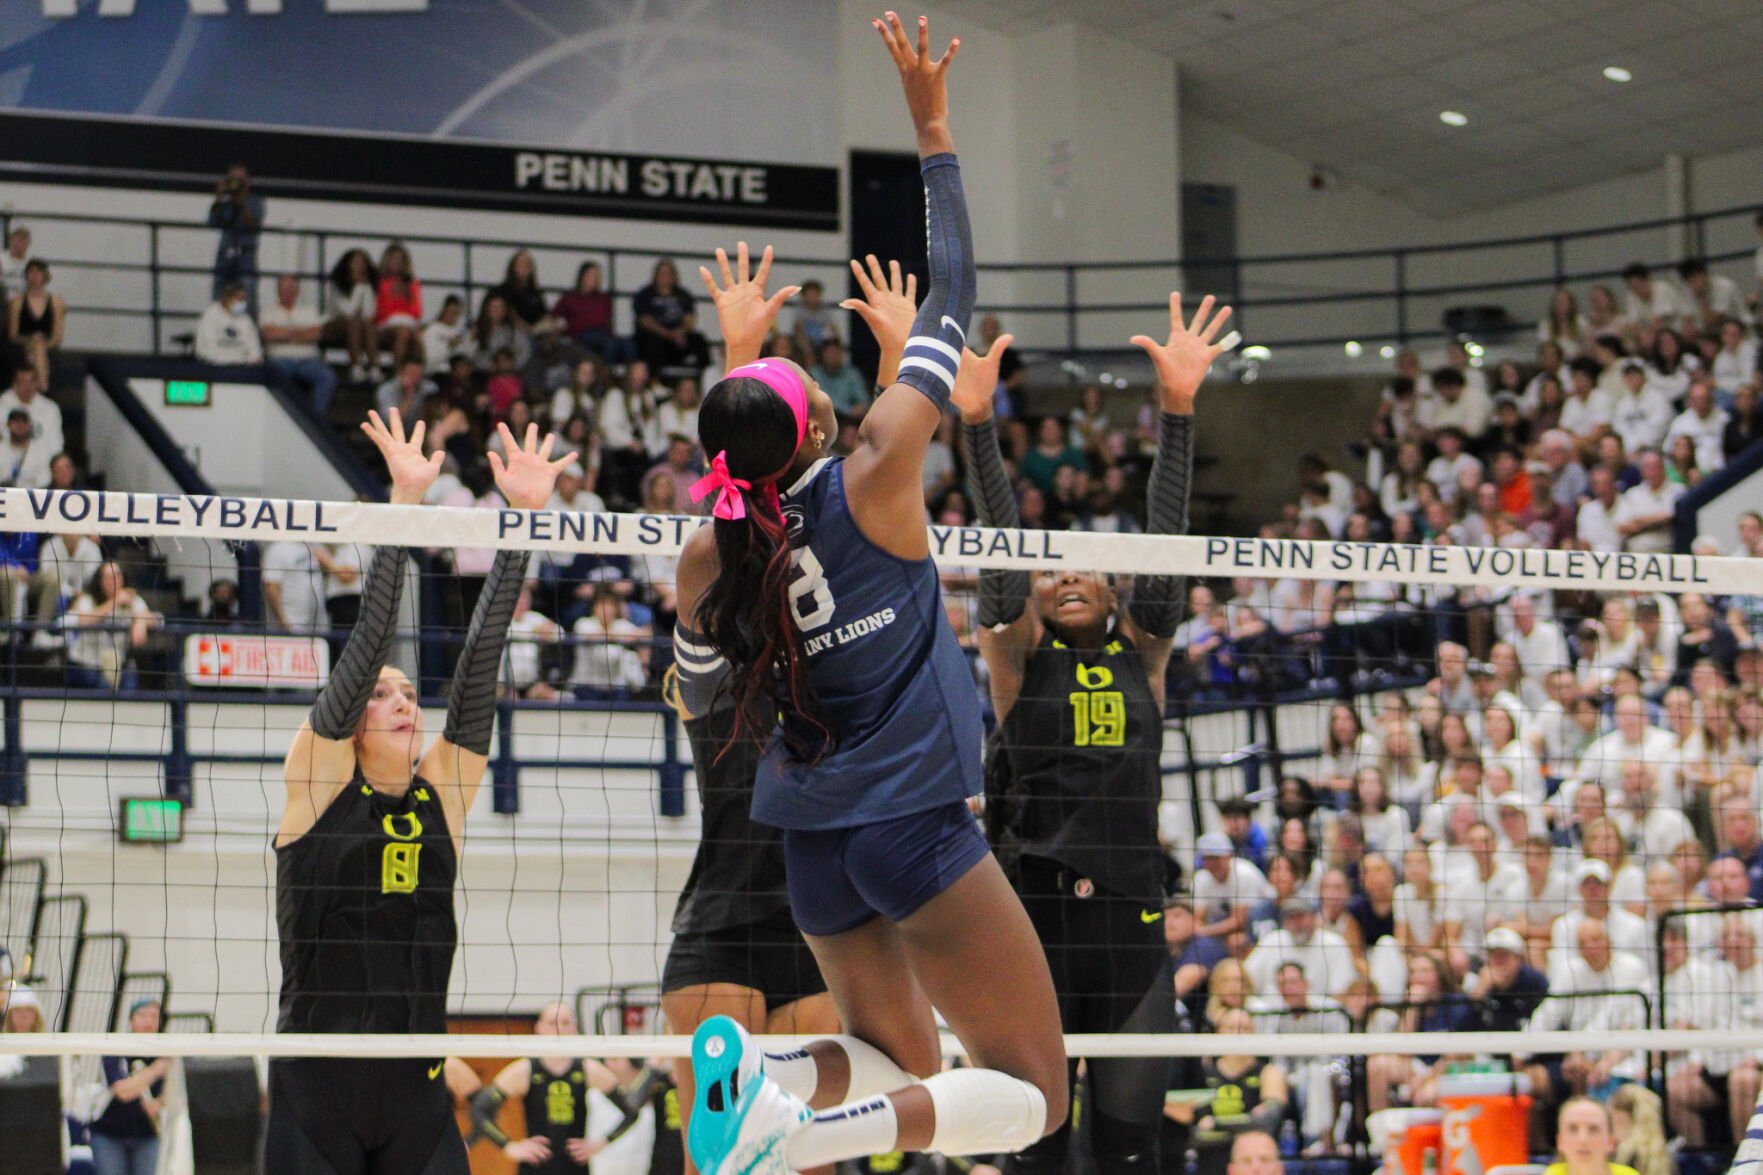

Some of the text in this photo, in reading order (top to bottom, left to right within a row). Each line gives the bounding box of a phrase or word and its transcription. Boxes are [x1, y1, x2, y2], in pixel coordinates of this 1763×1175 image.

[514, 153, 768, 202] PENN STATE
[27, 488, 338, 532] VOLLEYBALL
[498, 510, 714, 546] PENN ST
[1205, 538, 1708, 583] PENN STATE VOLLEYBALL
[834, 607, 896, 645] LIONS
[235, 645, 320, 673] FIRST AID
[1069, 691, 1126, 746] 19
